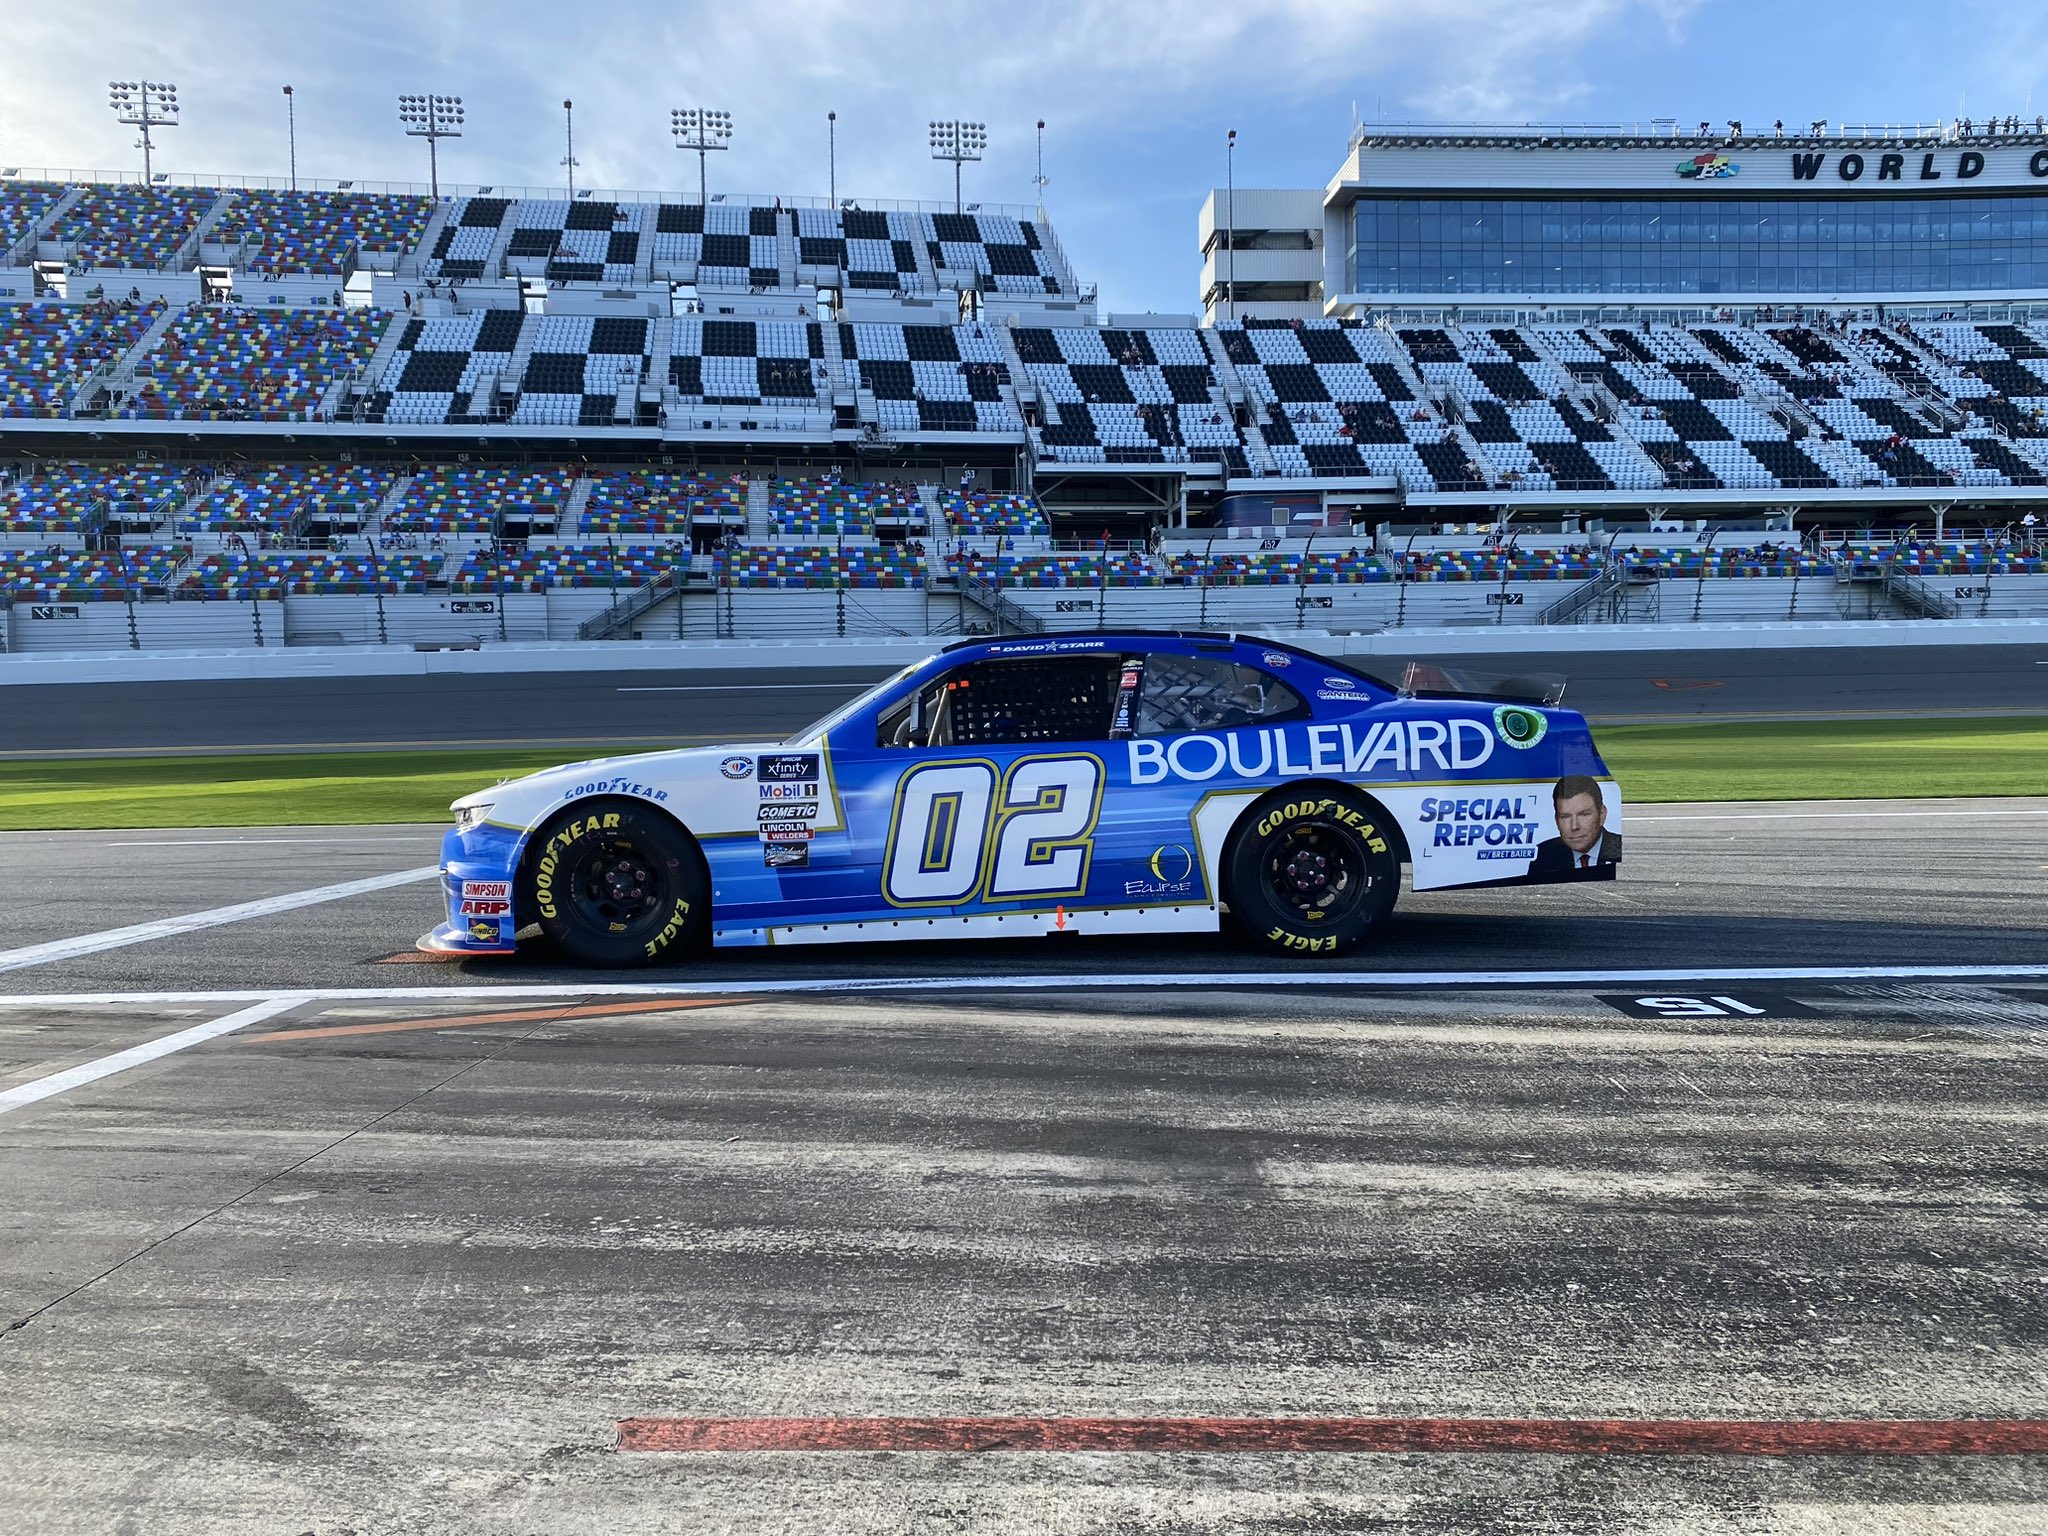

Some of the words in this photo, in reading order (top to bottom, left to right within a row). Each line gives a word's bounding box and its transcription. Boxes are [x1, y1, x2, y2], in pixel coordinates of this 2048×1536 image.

[1792, 151, 1985, 180] WORLD
[266, 274, 279, 282] 363
[136, 450, 148, 460] 157
[662, 456, 674, 465] 155
[831, 465, 842, 474] 154
[1264, 540, 1276, 550] 152
[1487, 536, 1498, 546] 151
[1700, 533, 1712, 543] 150
[1002, 645, 1044, 653] DAVID
[1059, 641, 1105, 649] STARR
[1128, 719, 1494, 784] BOULEVARD
[768, 762, 809, 776] xfinity
[564, 778, 669, 801] GOODYEAR
[760, 784, 800, 798] Mobil
[760, 804, 817, 818] COMETIC
[1419, 797, 1526, 822] SPECIAL
[762, 823, 805, 832] LINCOLN
[882, 752, 1107, 908] 02
[1257, 799, 1387, 854] GOODYEAR
[1433, 822, 1539, 847] REPORT
[1480, 850, 1491, 859] w/
[1491, 849, 1509, 858] BRET
[1510, 849, 1532, 858] BAIER
[536, 813, 621, 919] GOODYEAR
[464, 883, 507, 896] SIMPSON
[461, 901, 510, 914] ARP
[470, 927, 499, 935] SUNOCO
[644, 898, 690, 957] EAGLE
[1267, 926, 1337, 951] EAGLE
[1635, 996, 1766, 1016] 15
